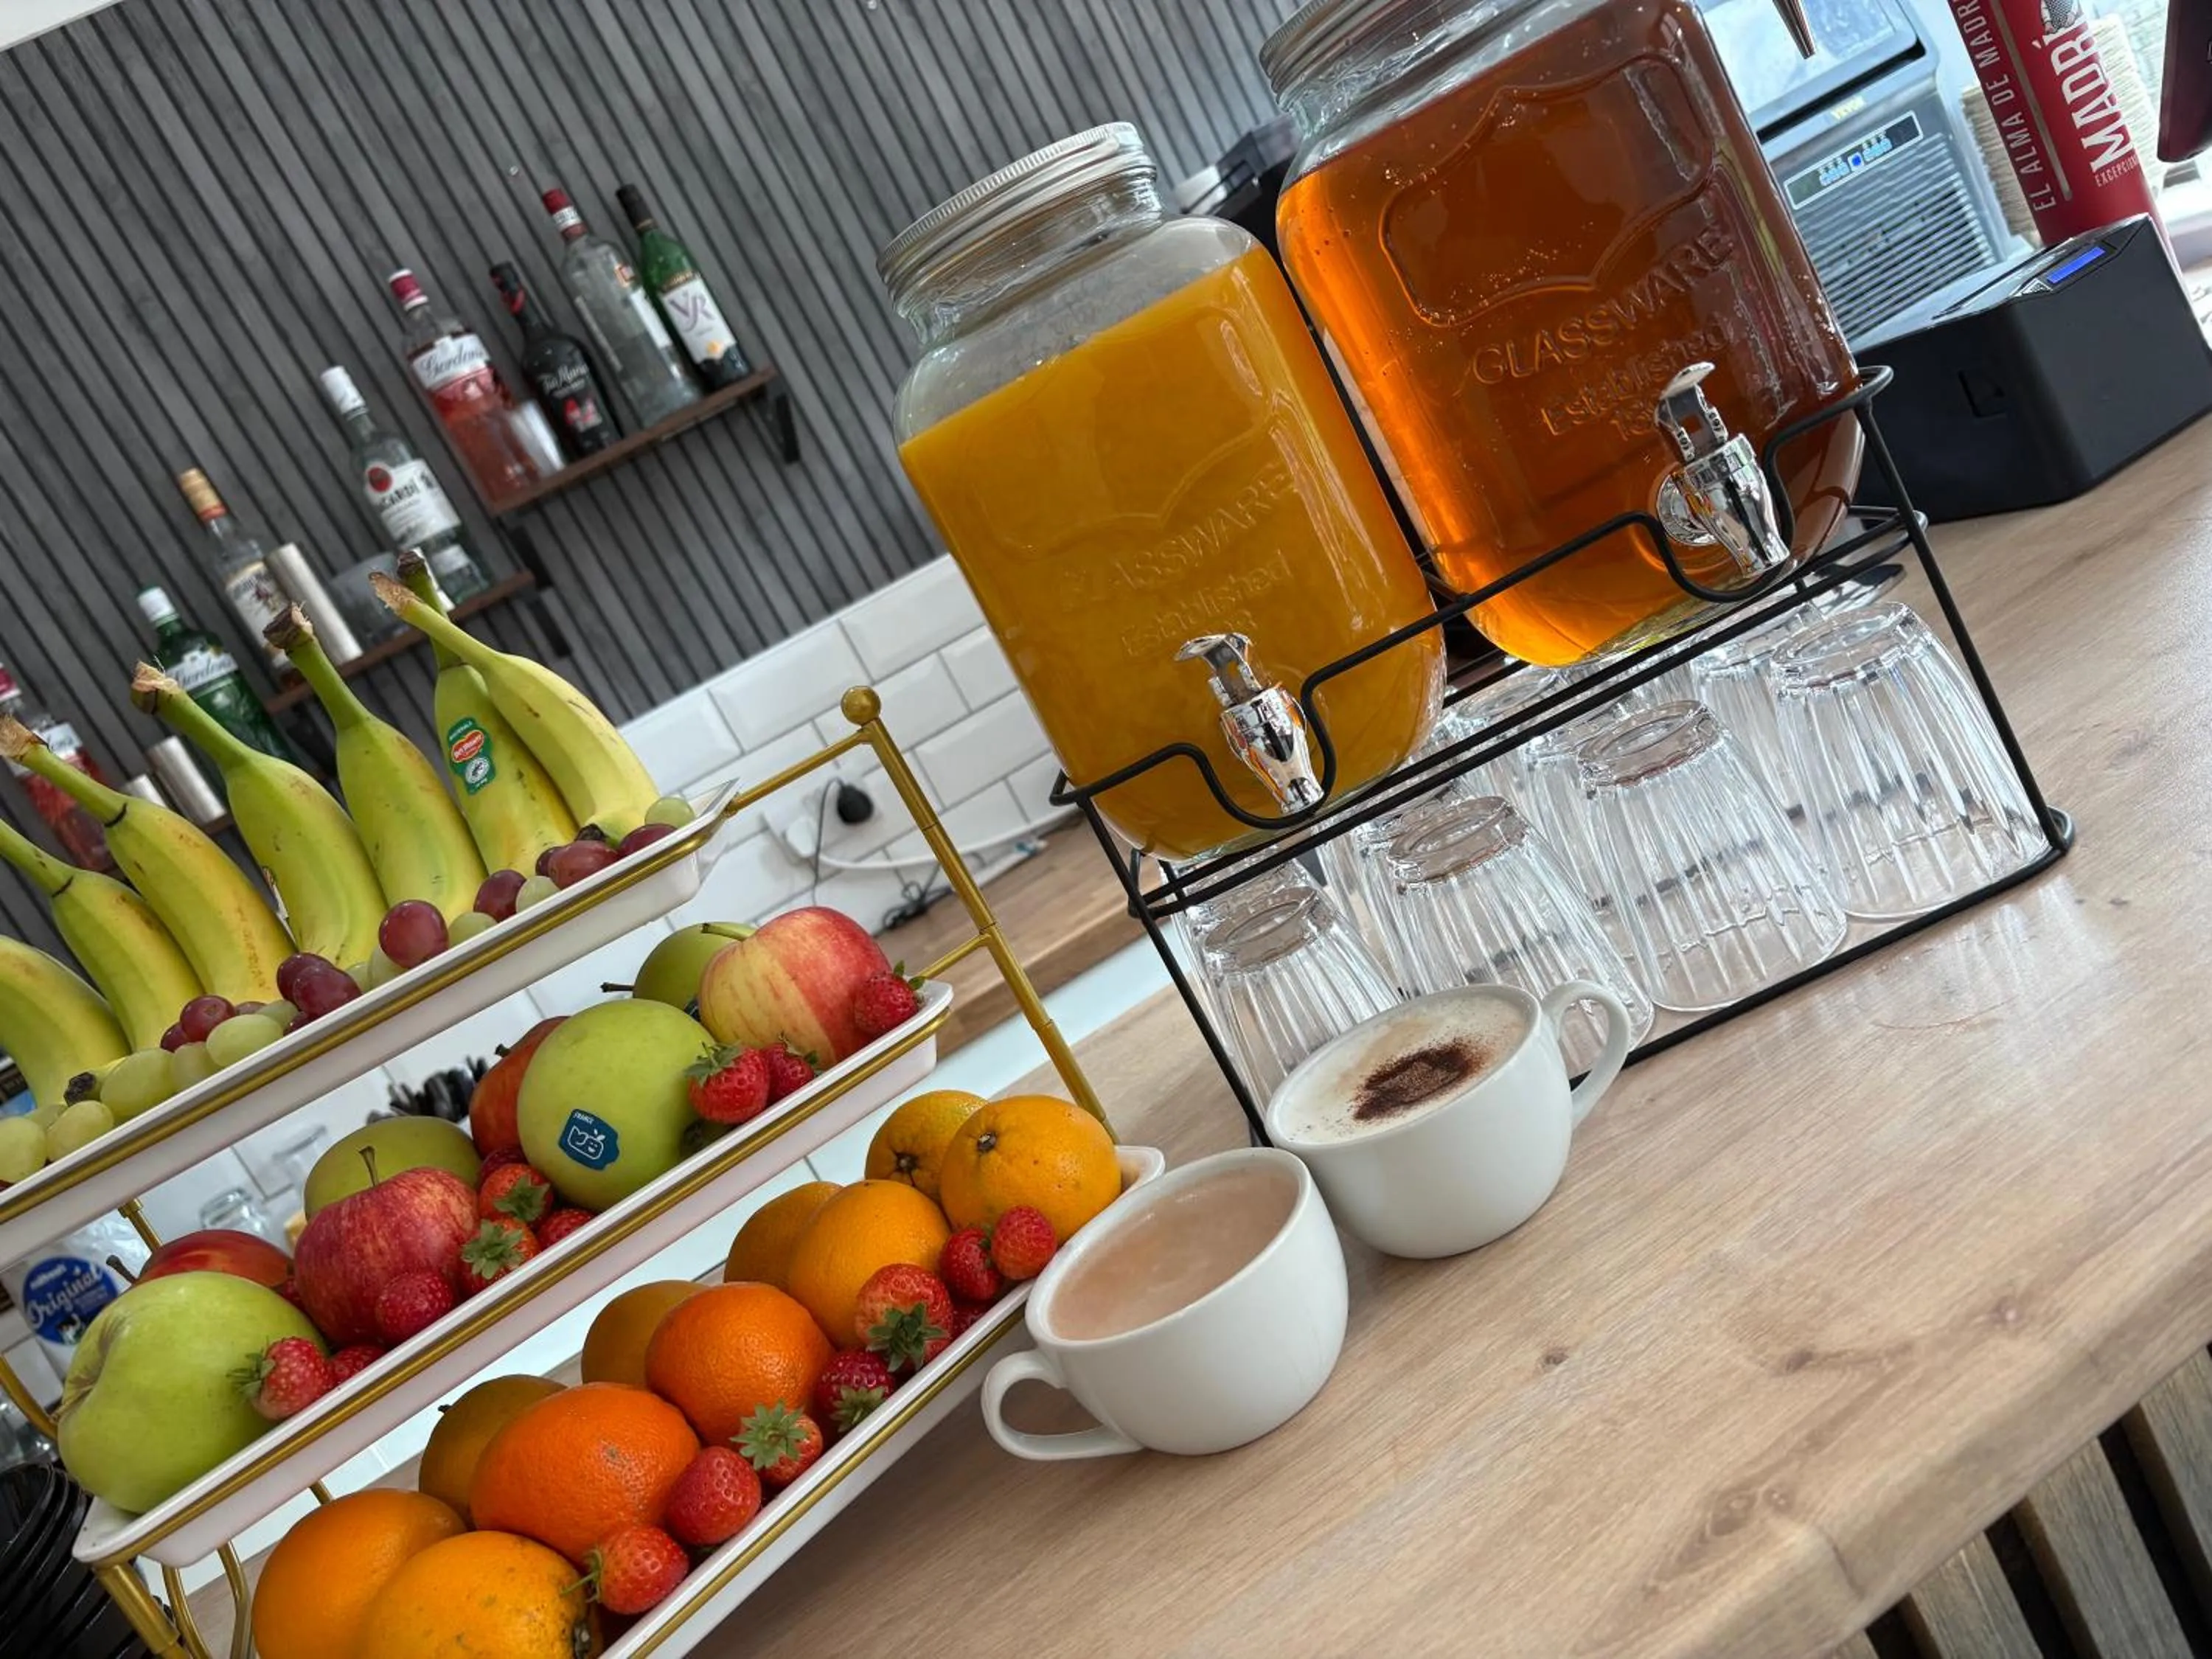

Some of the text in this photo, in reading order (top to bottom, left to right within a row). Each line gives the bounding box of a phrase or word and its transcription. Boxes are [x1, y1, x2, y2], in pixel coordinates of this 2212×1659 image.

[1985, 74, 2015, 105] DE
[2000, 111, 2043, 174] ALMA
[2029, 182, 2056, 212] EL
[1473, 223, 1733, 385] GLASSWARE
[28, 1261, 105, 1330] Original
